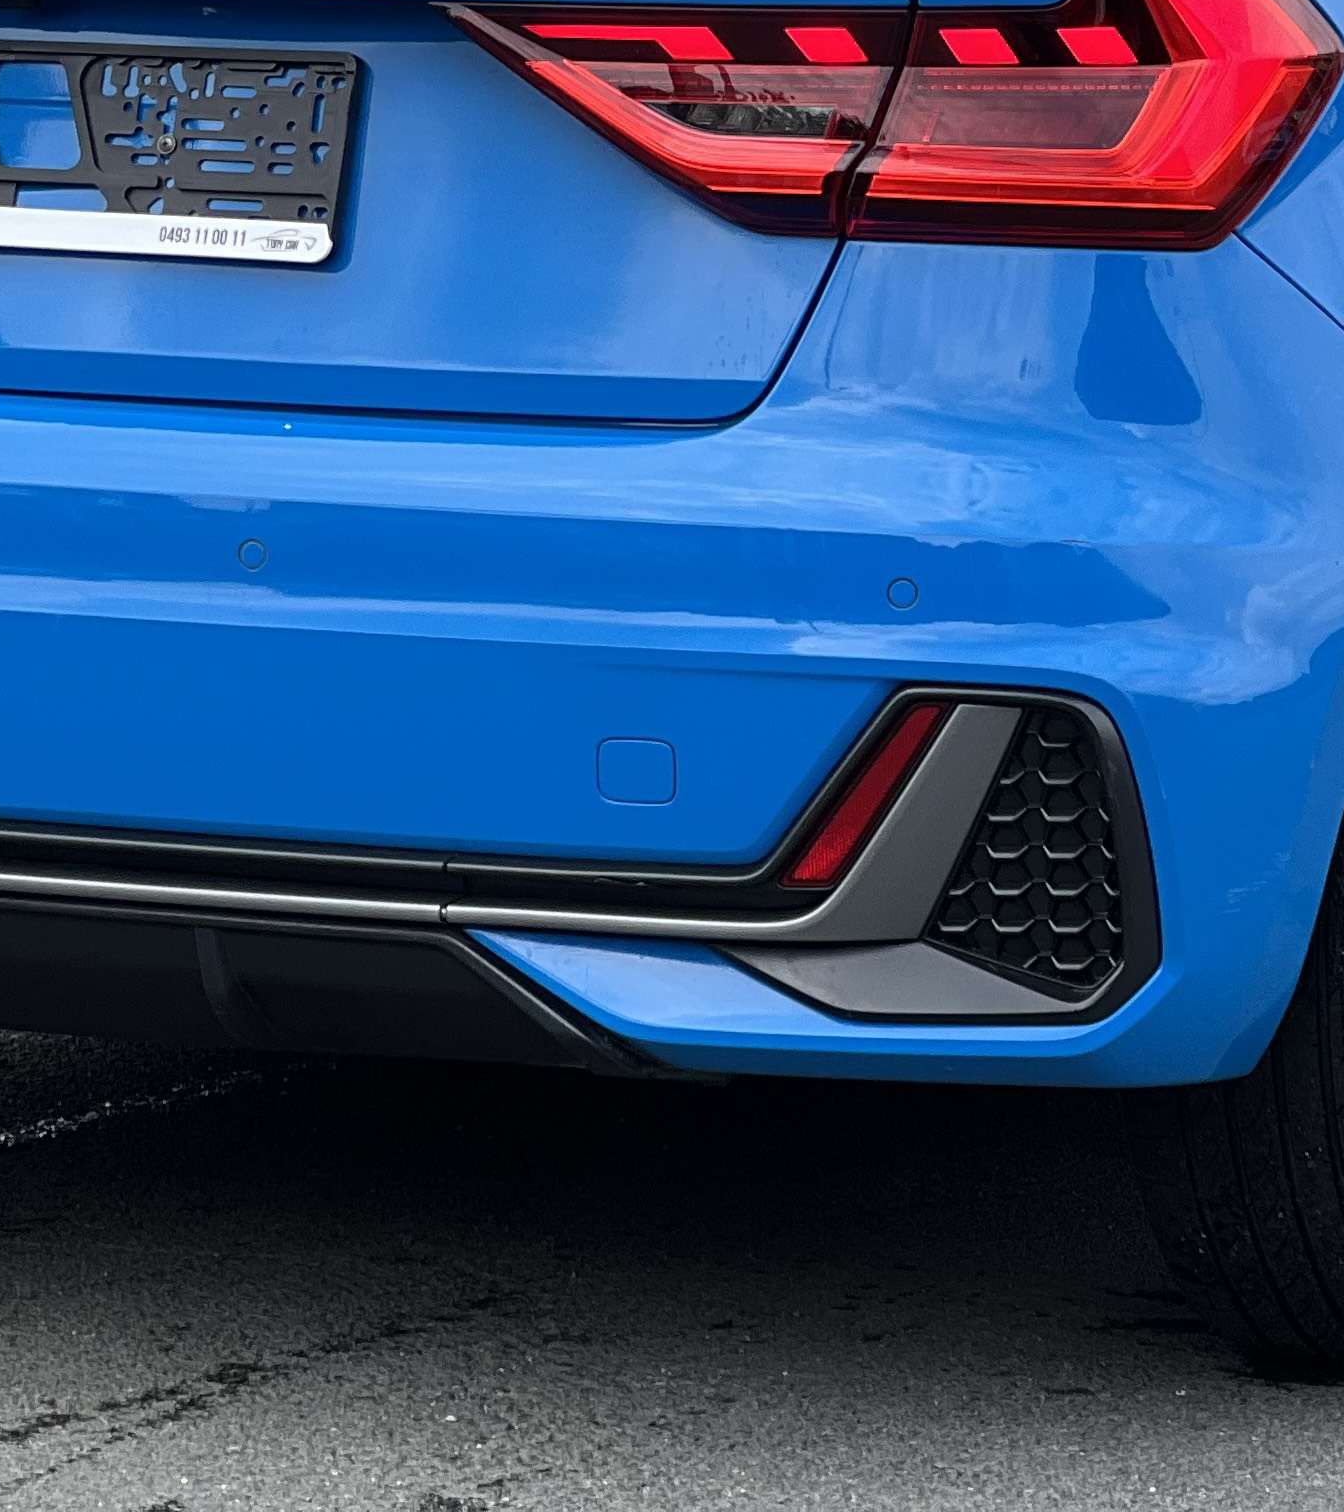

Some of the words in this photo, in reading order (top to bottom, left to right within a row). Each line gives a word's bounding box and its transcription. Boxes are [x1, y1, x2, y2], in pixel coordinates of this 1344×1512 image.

[159, 226, 191, 244] 0493
[195, 228, 208, 245] 11
[212, 229, 229, 246] 00
[233, 230, 247, 247] 11
